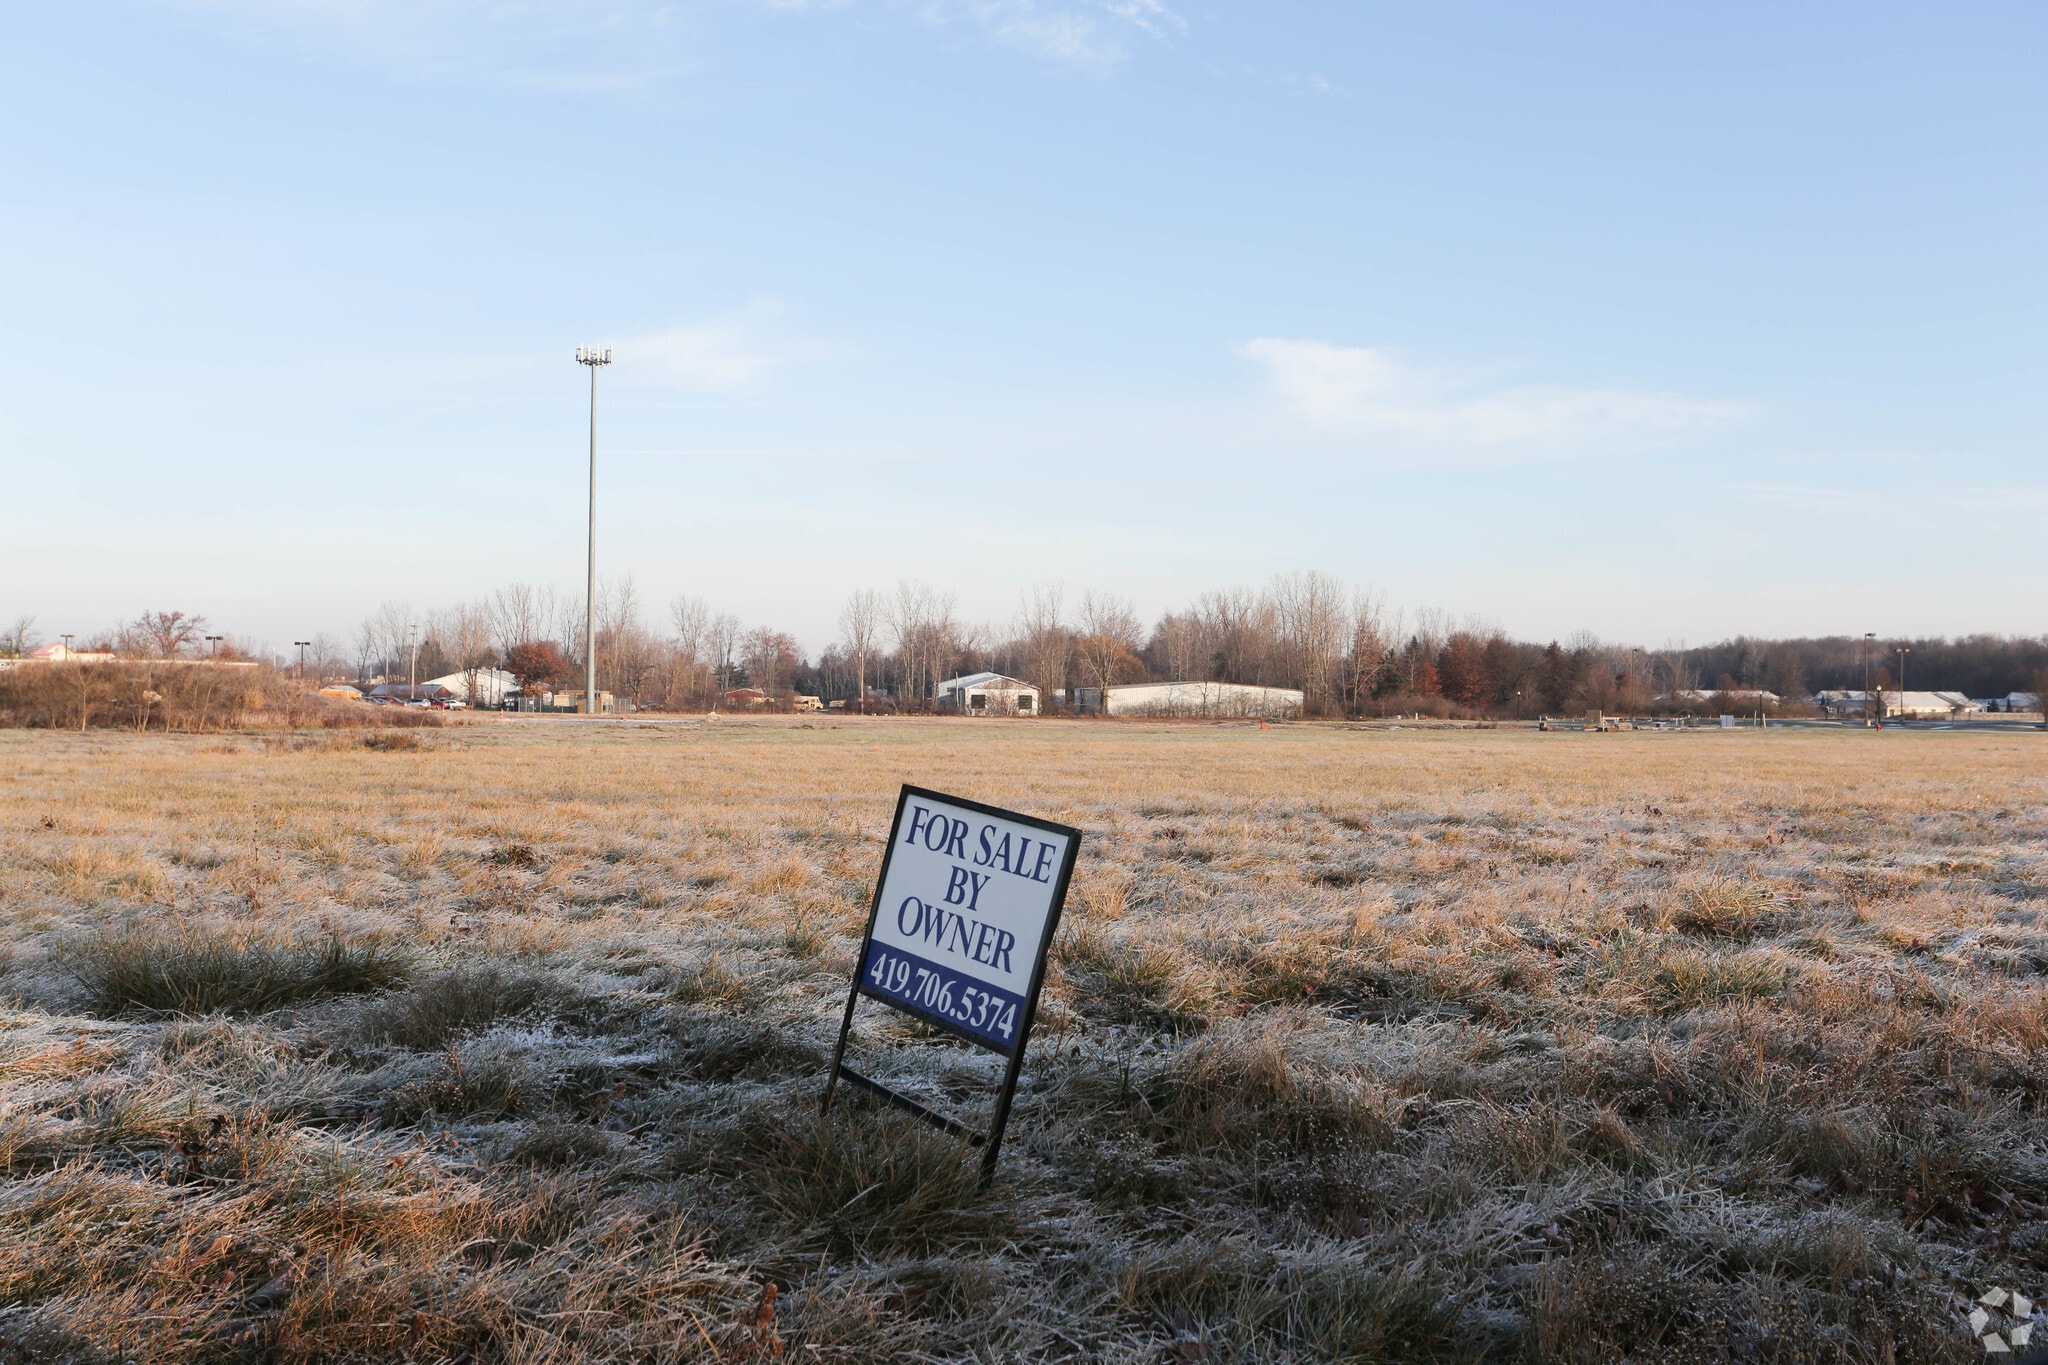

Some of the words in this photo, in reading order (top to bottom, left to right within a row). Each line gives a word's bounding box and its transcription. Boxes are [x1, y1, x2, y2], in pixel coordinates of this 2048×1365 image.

[905, 806, 969, 859] FOR
[973, 824, 1057, 884] SALE
[943, 865, 991, 911] BY
[898, 896, 1016, 973] OWNER
[870, 953, 1017, 1039] 419.706.5374
